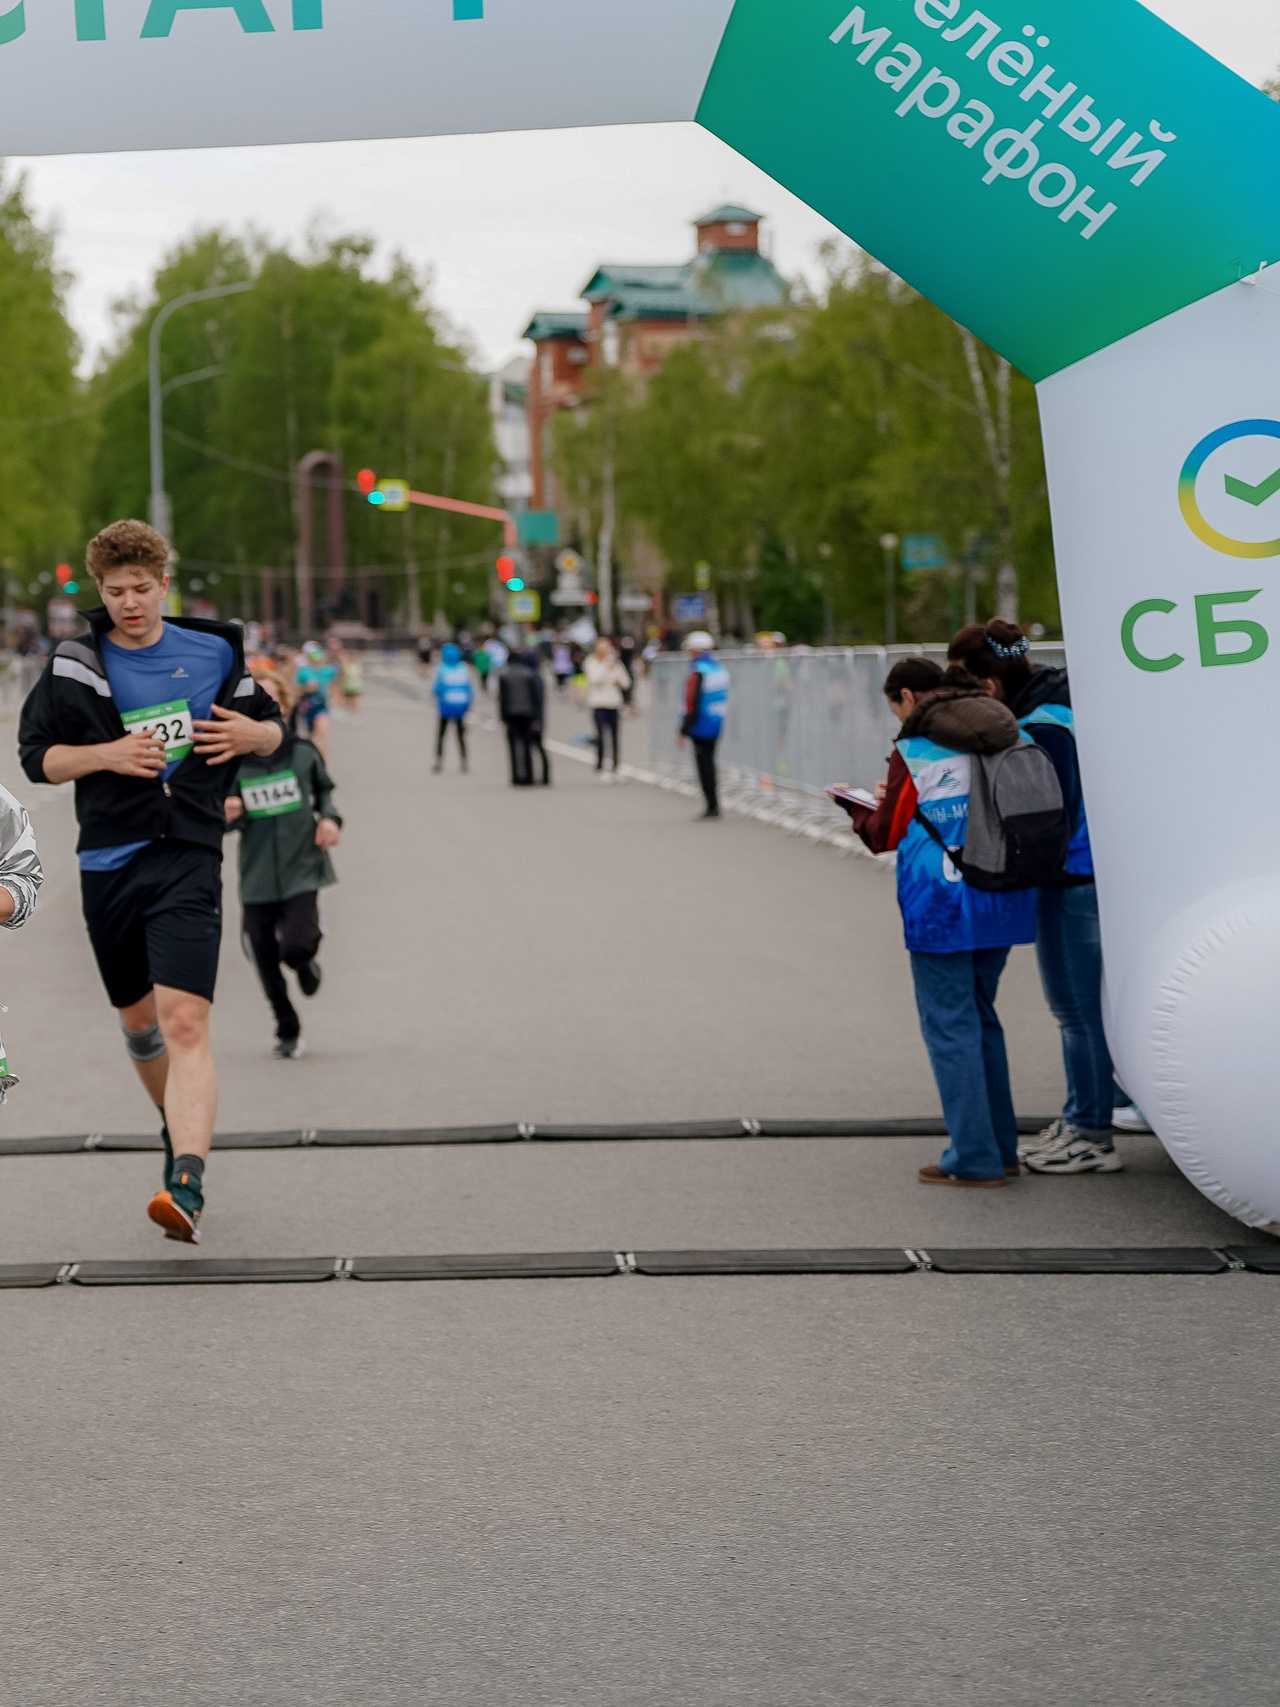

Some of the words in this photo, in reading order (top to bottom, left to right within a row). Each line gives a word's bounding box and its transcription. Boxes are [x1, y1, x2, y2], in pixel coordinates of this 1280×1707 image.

[828, 5, 1118, 240] марафон
[898, 0, 1177, 187] елёный
[1121, 589, 1269, 672] СБ
[124, 719, 186, 743] 32
